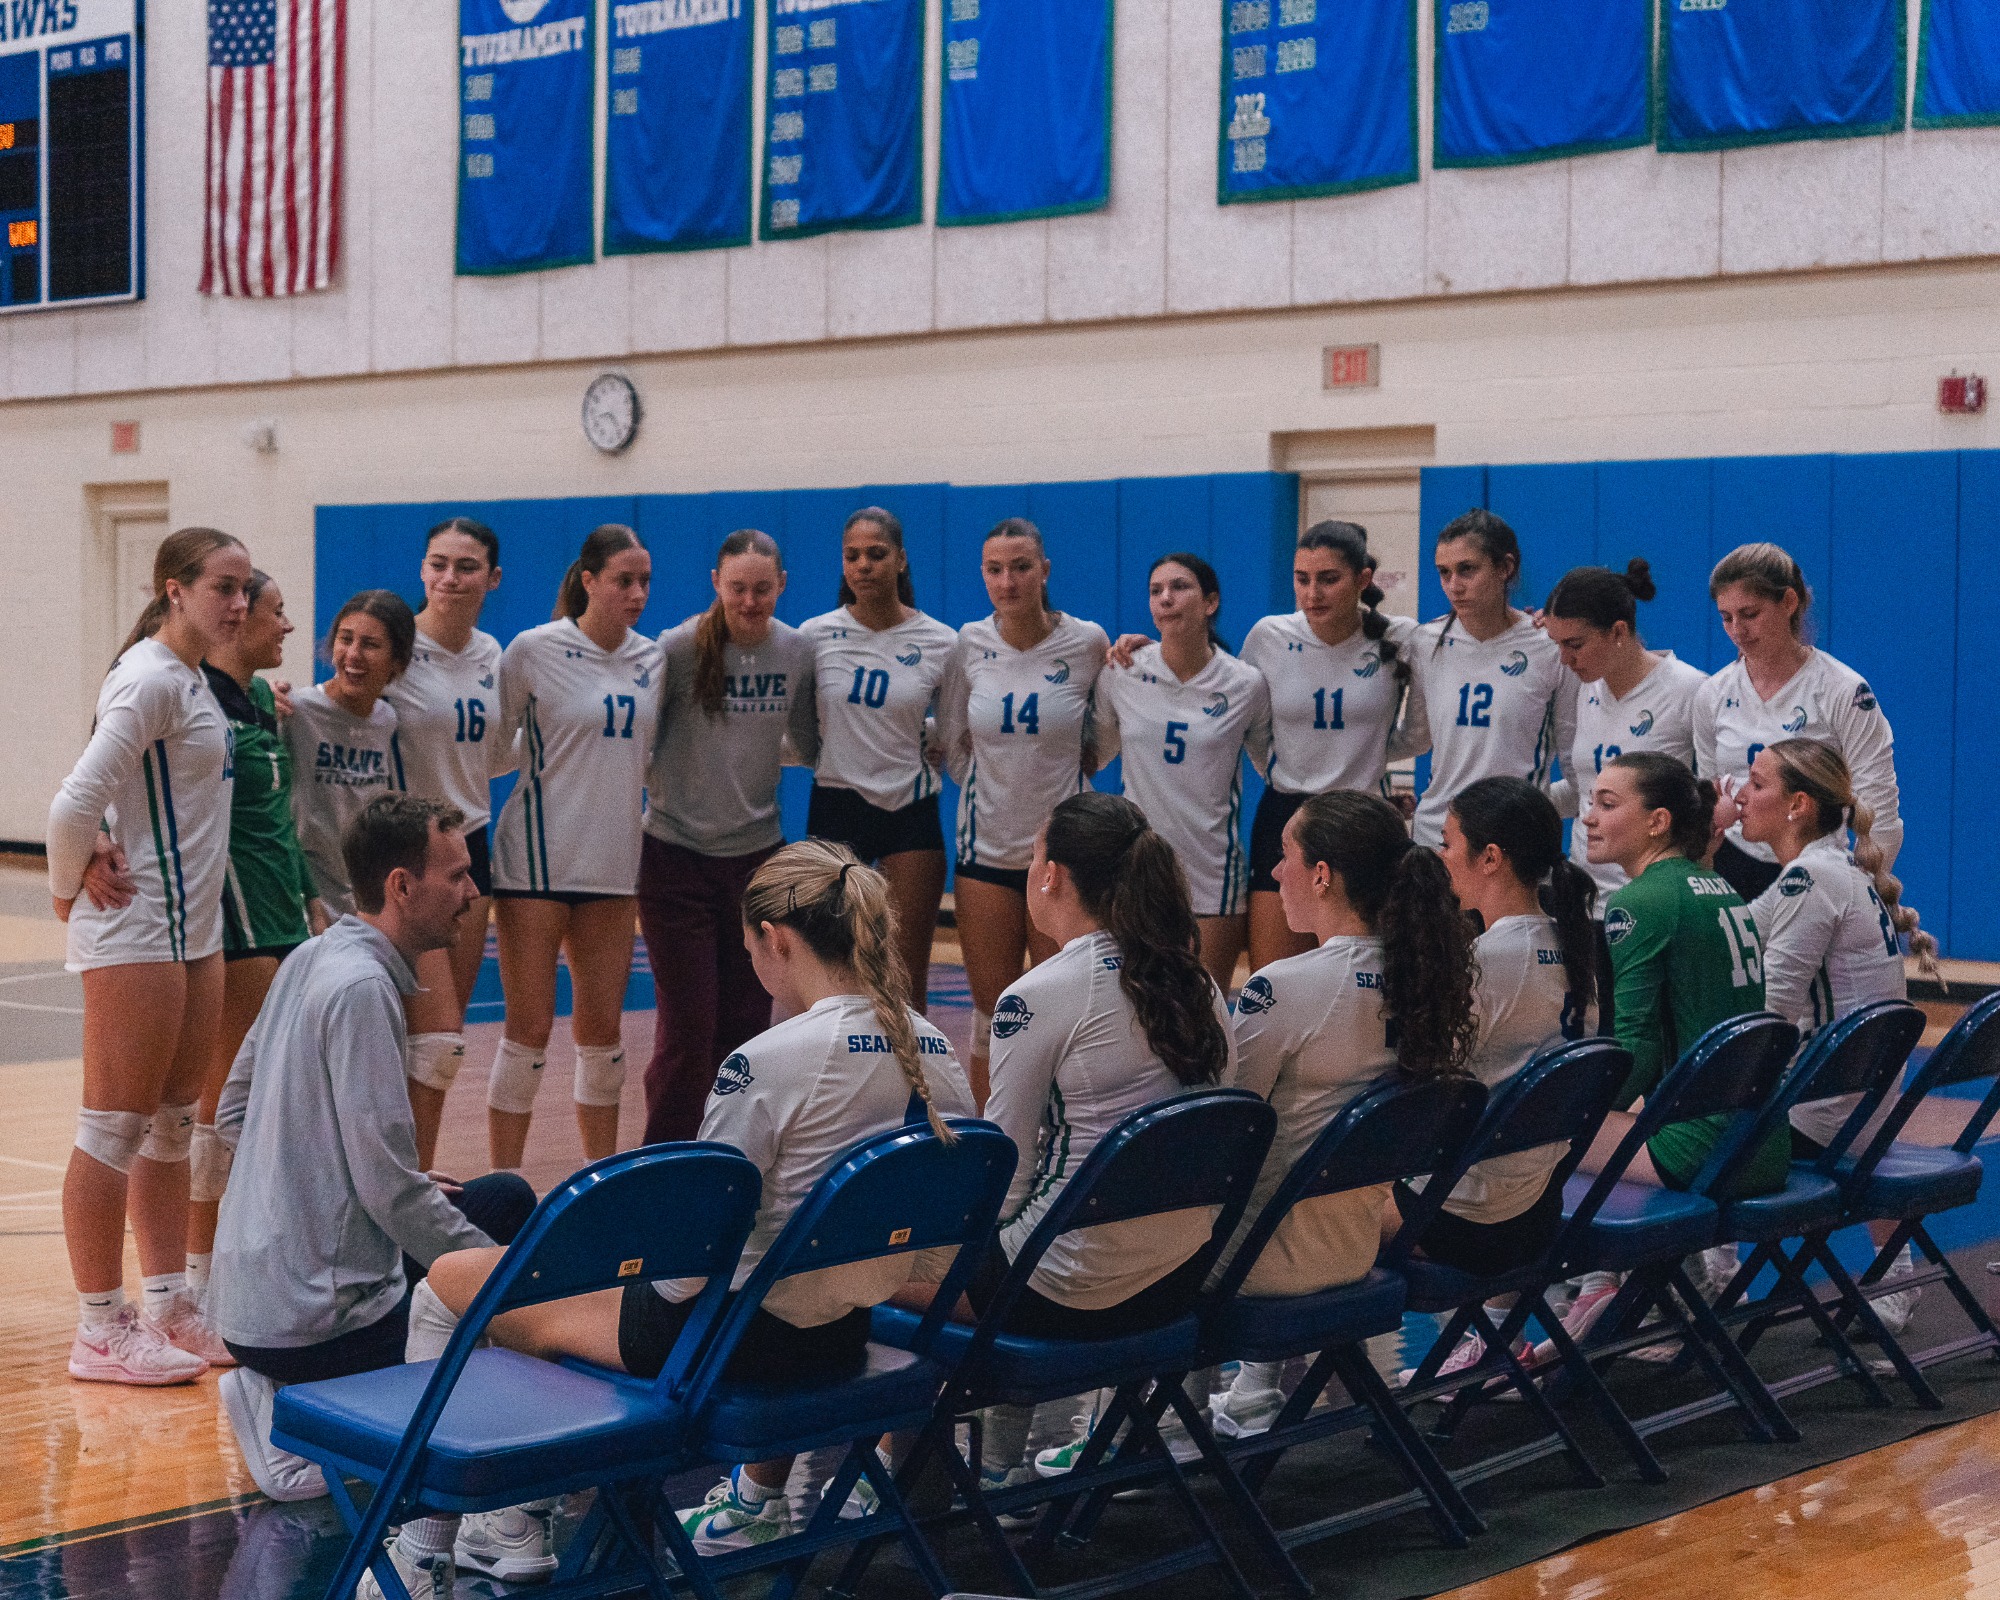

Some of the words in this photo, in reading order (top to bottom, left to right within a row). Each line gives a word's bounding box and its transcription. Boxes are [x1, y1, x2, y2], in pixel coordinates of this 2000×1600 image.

[723, 673, 787, 698] ALVE
[847, 665, 889, 709] 10
[1455, 682, 1494, 728] 12
[454, 698, 486, 742] 16
[602, 694, 636, 738] 17
[1000, 692, 1039, 735] 14
[1312, 687, 1345, 730] 11
[316, 742, 384, 776] SALVE
[1163, 721, 1189, 764] 5
[1718, 905, 1762, 988] 15
[847, 1034, 948, 1055] SEAHWKS
